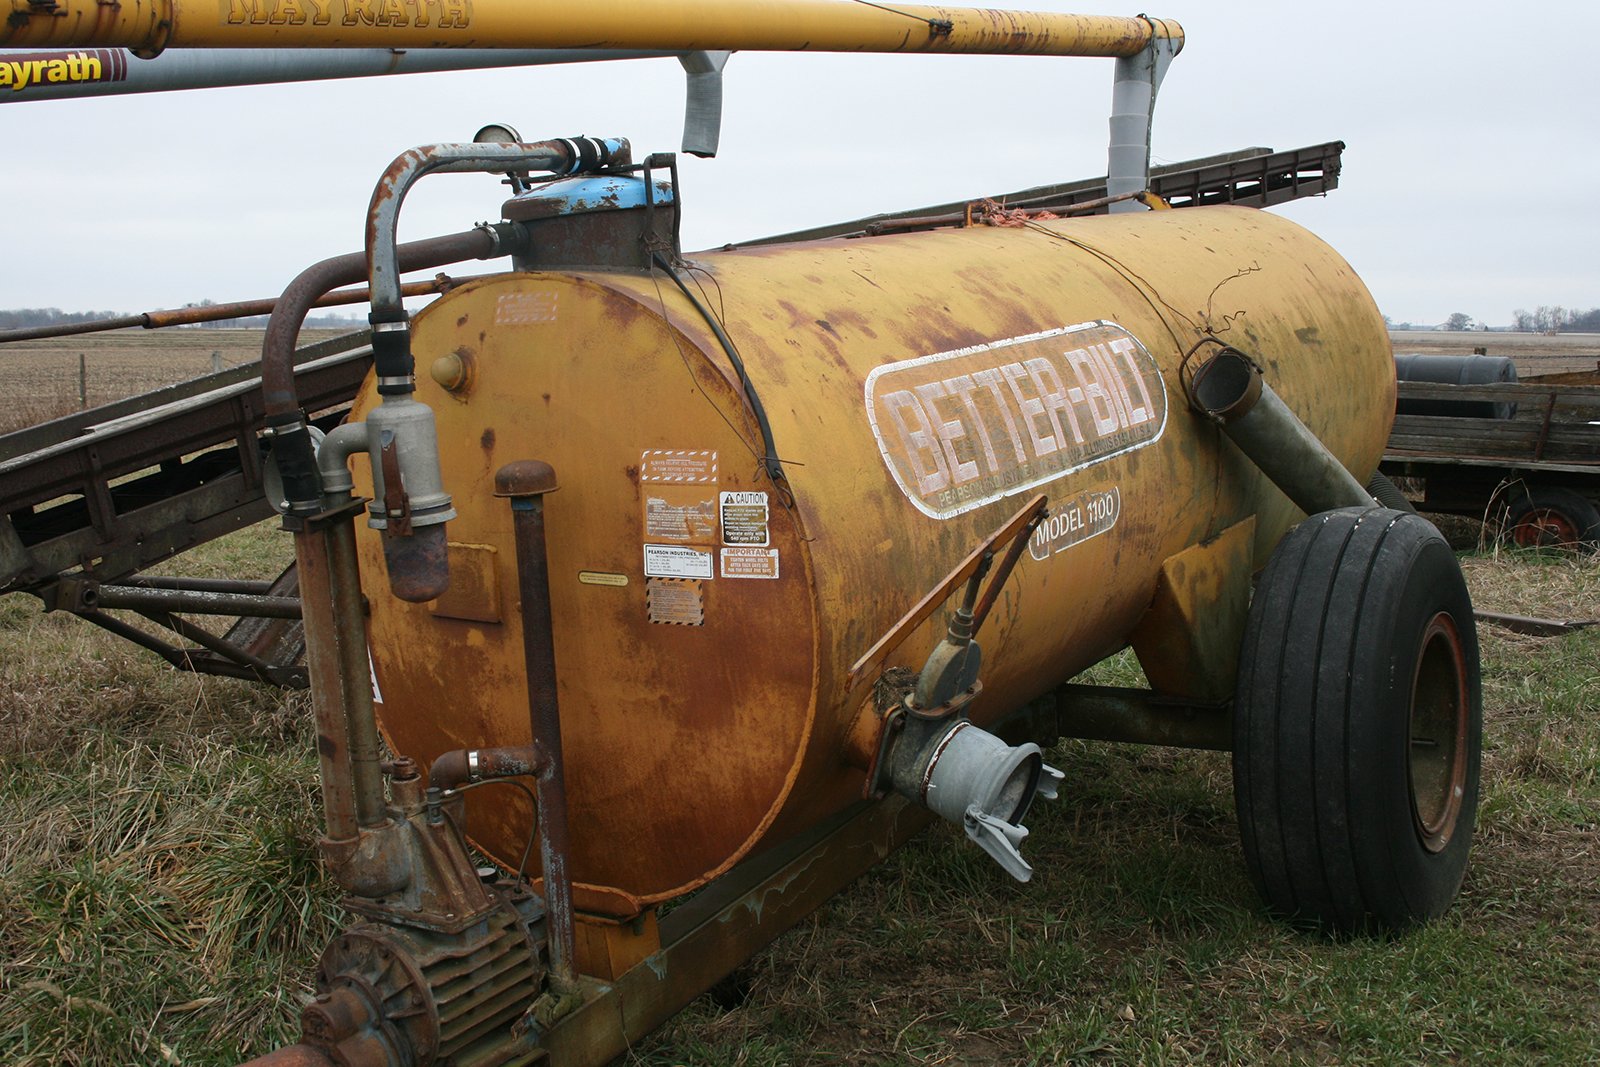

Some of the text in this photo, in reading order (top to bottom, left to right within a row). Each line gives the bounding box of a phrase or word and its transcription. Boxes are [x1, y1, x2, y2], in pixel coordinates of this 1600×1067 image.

[226, 0, 471, 28] MAYRATH
[880, 336, 1156, 496] BETTER-BILT
[735, 493, 764, 504] CAUTION
[1036, 494, 1115, 548] MODEL 1100
